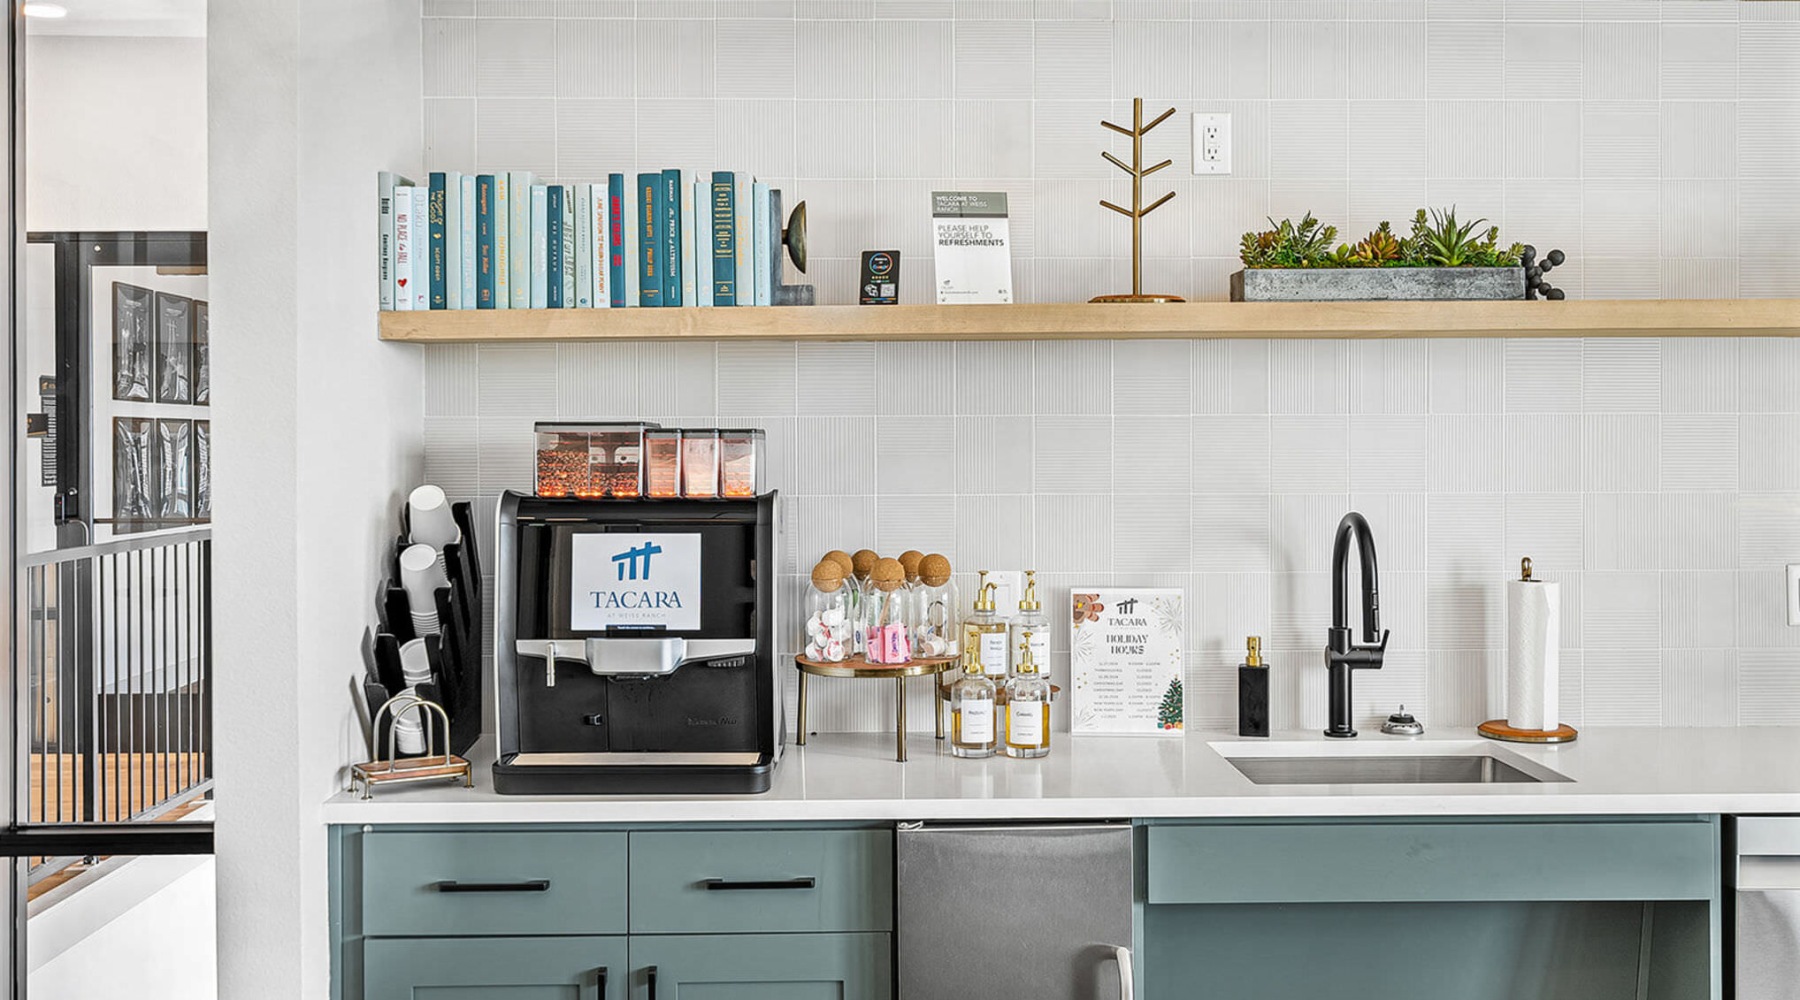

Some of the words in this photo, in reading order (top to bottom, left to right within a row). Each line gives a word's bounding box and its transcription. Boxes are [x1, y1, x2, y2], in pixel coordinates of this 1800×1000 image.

[397, 213, 407, 223] NO
[397, 224, 407, 241] PLACE
[938, 224, 967, 232] PLEASE
[969, 224, 989, 232] HELP
[938, 231, 980, 239] YOURSELF
[981, 231, 993, 239] TO
[938, 238, 1005, 247] REFRESHMENTS
[397, 252, 407, 264] FALL
[589, 591, 682, 609] TACARA
[1107, 617, 1148, 626] TACARA
[1106, 634, 1149, 643] HOLIDAY
[1110, 645, 1145, 654] HOURS
